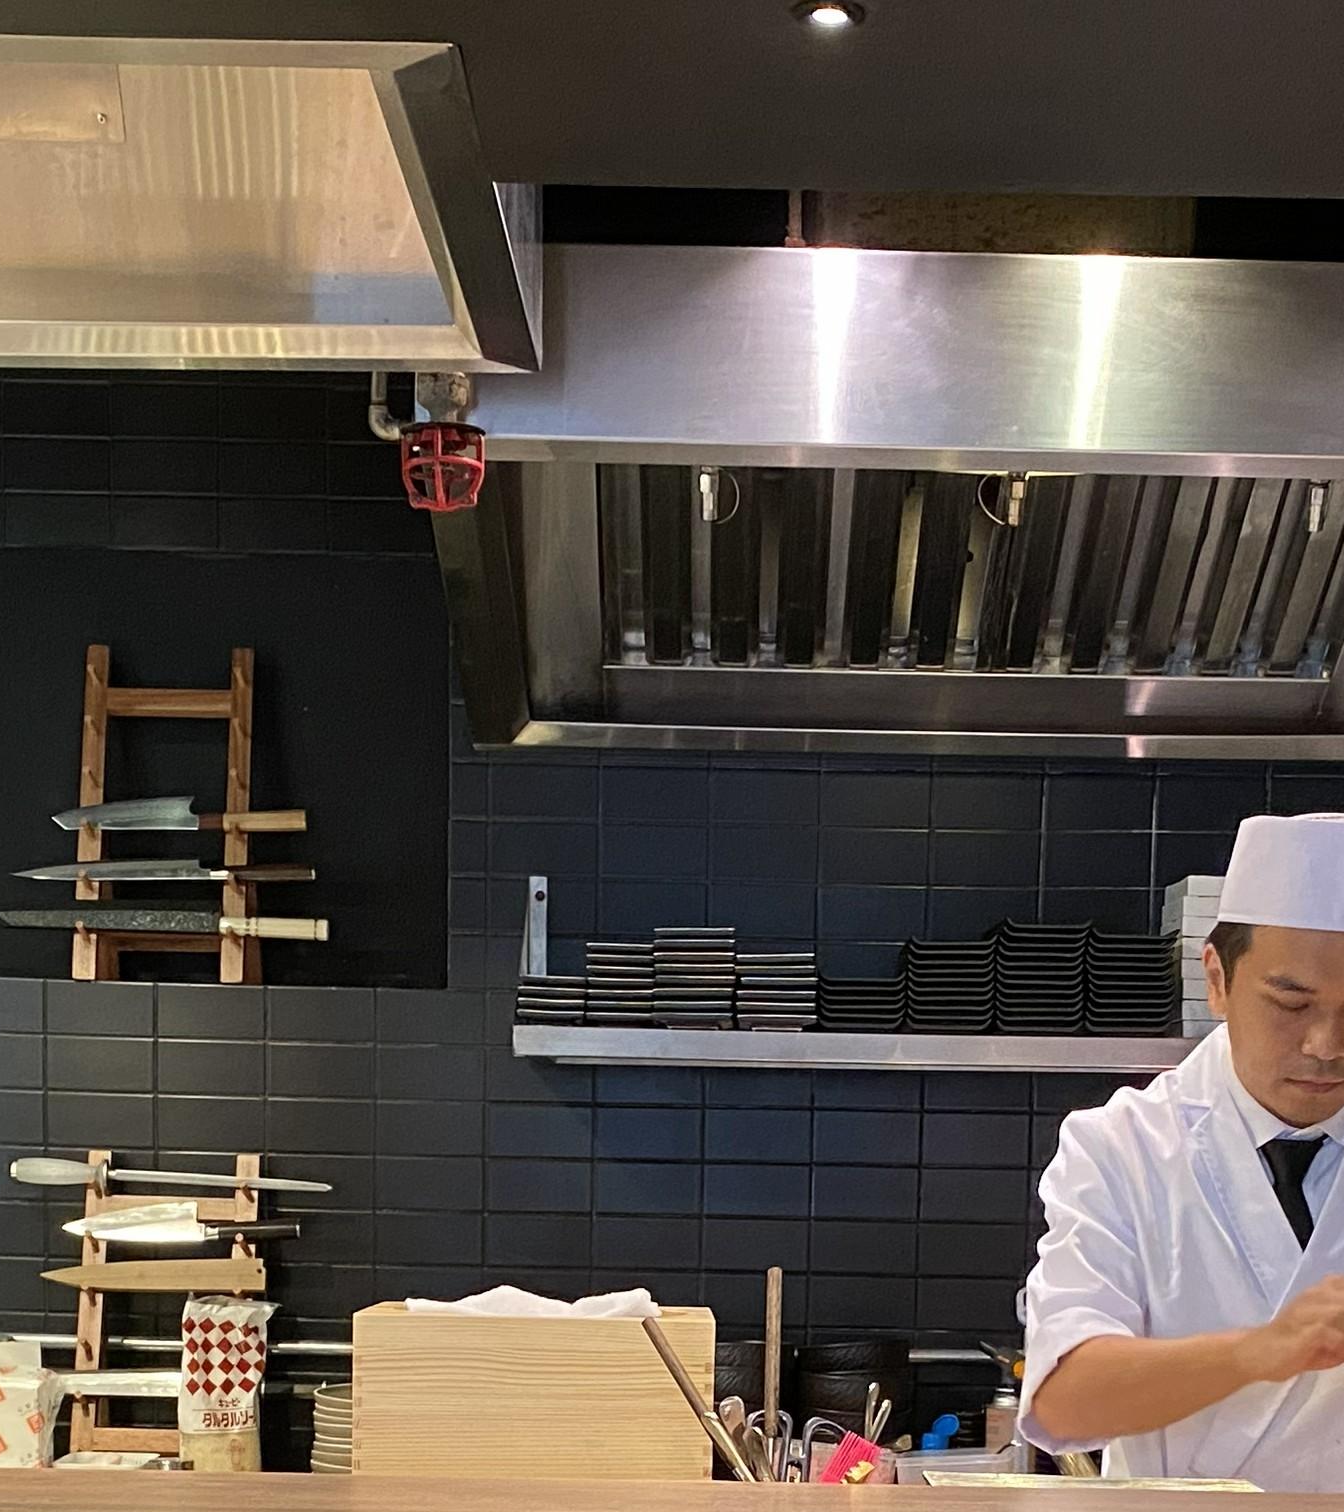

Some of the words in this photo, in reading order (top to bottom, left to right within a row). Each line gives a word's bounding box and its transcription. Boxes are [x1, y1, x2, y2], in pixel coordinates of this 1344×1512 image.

[202, 1410, 257, 1428] タルタルソー
